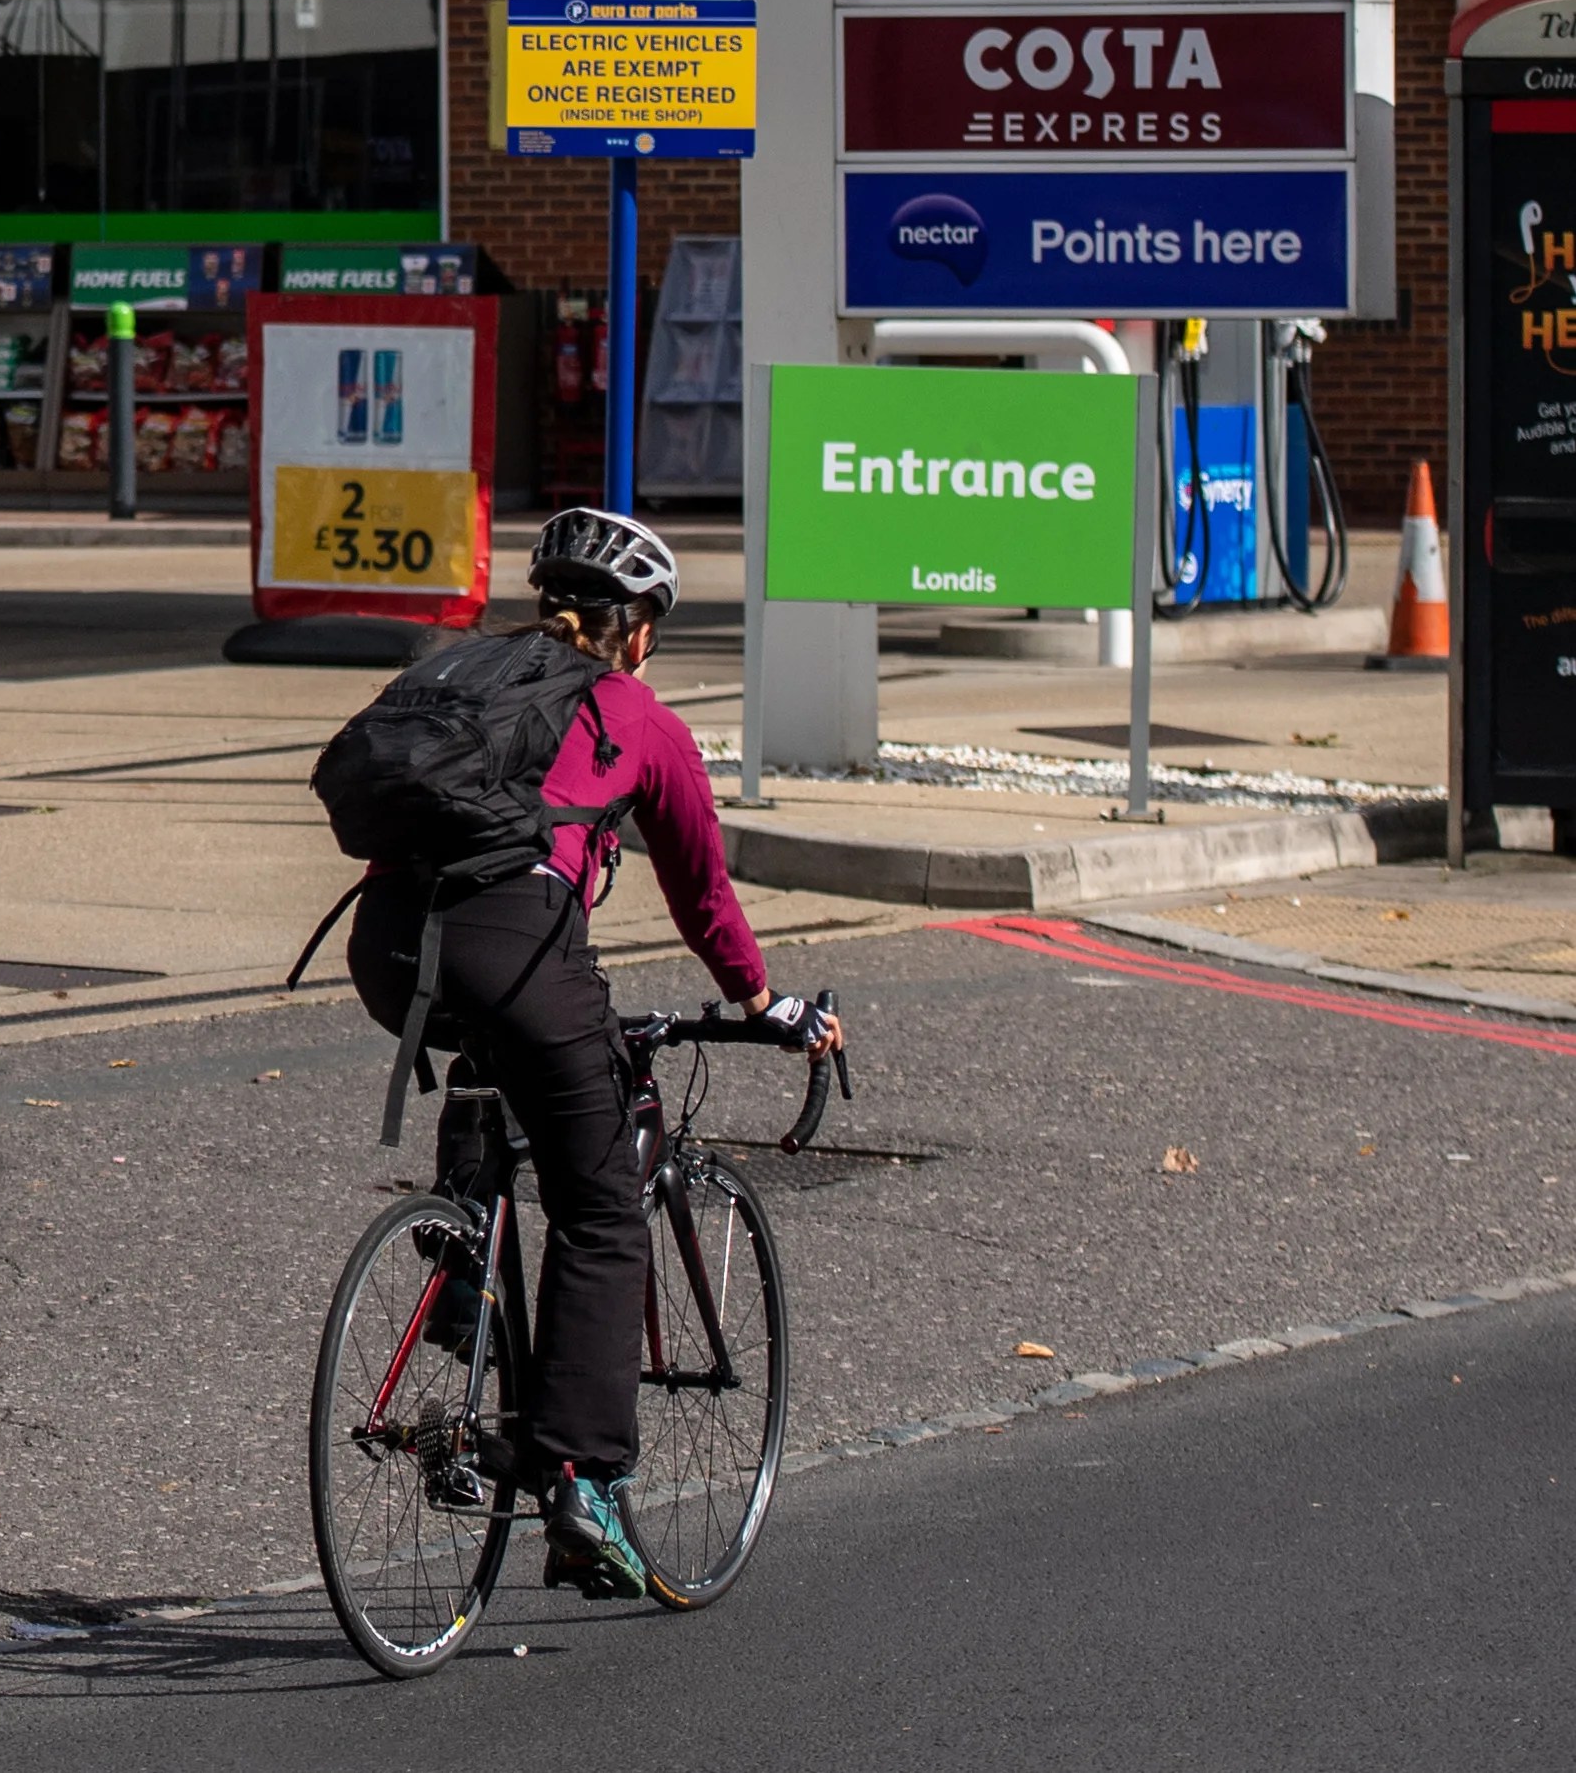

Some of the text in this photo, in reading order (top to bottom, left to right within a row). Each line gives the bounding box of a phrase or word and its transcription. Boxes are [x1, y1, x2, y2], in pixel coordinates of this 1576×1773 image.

[590, 5, 626, 18] euro
[629, 5, 652, 18] car
[654, 3, 698, 20] parks
[521, 33, 743, 53] ELECTRIC VEHICLES
[562, 60, 703, 78] ARE EXEMPT
[963, 26, 1222, 100] COSTA
[527, 85, 736, 104] ONCE REGISTERED
[559, 108, 703, 124] (INSIDE THE SHOP)
[1003, 113, 1222, 143] EXPRESS
[898, 222, 978, 245] nectar
[1031, 219, 1303, 264] Points here
[73, 268, 186, 291] HOME FUELS
[283, 270, 398, 289] HOME FUELS
[821, 440, 1097, 501] Entrance
[341, 481, 404, 523] 2 FOR
[314, 525, 434, 574] £3.30
[911, 565, 997, 594] Londis
